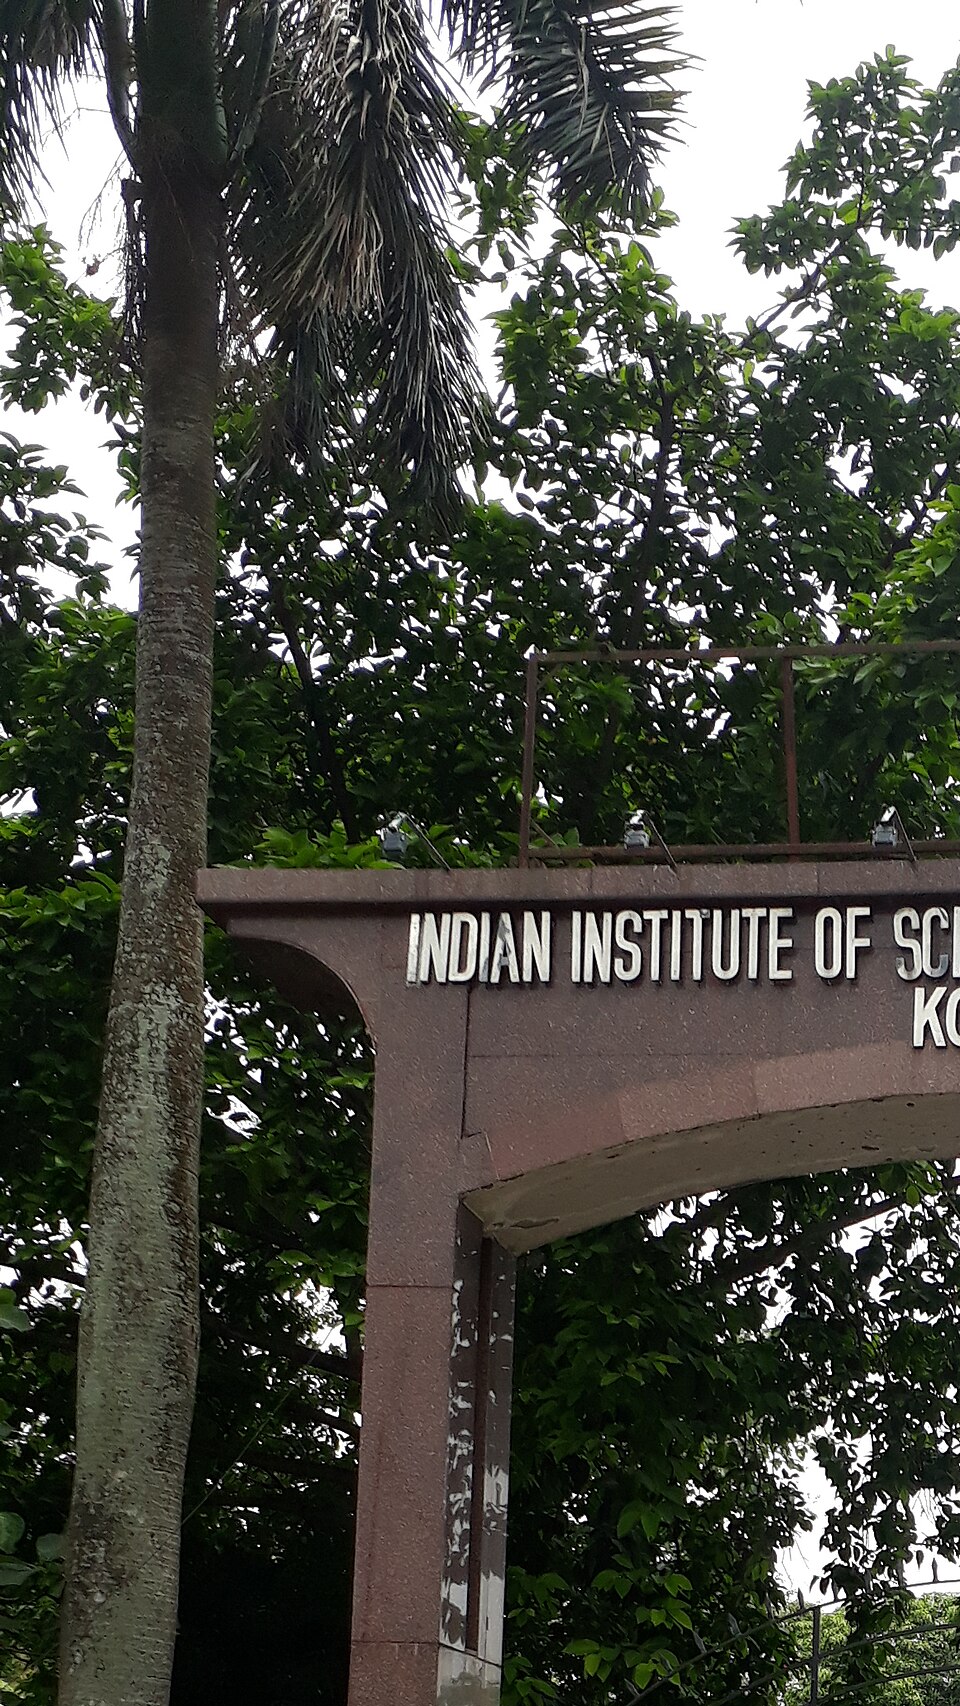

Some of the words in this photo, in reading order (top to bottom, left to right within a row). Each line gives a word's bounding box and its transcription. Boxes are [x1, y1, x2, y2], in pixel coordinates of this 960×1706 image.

[406, 910, 551, 984] INDIAN
[571, 907, 794, 983] INSTITUTE
[813, 906, 872, 980] OF
